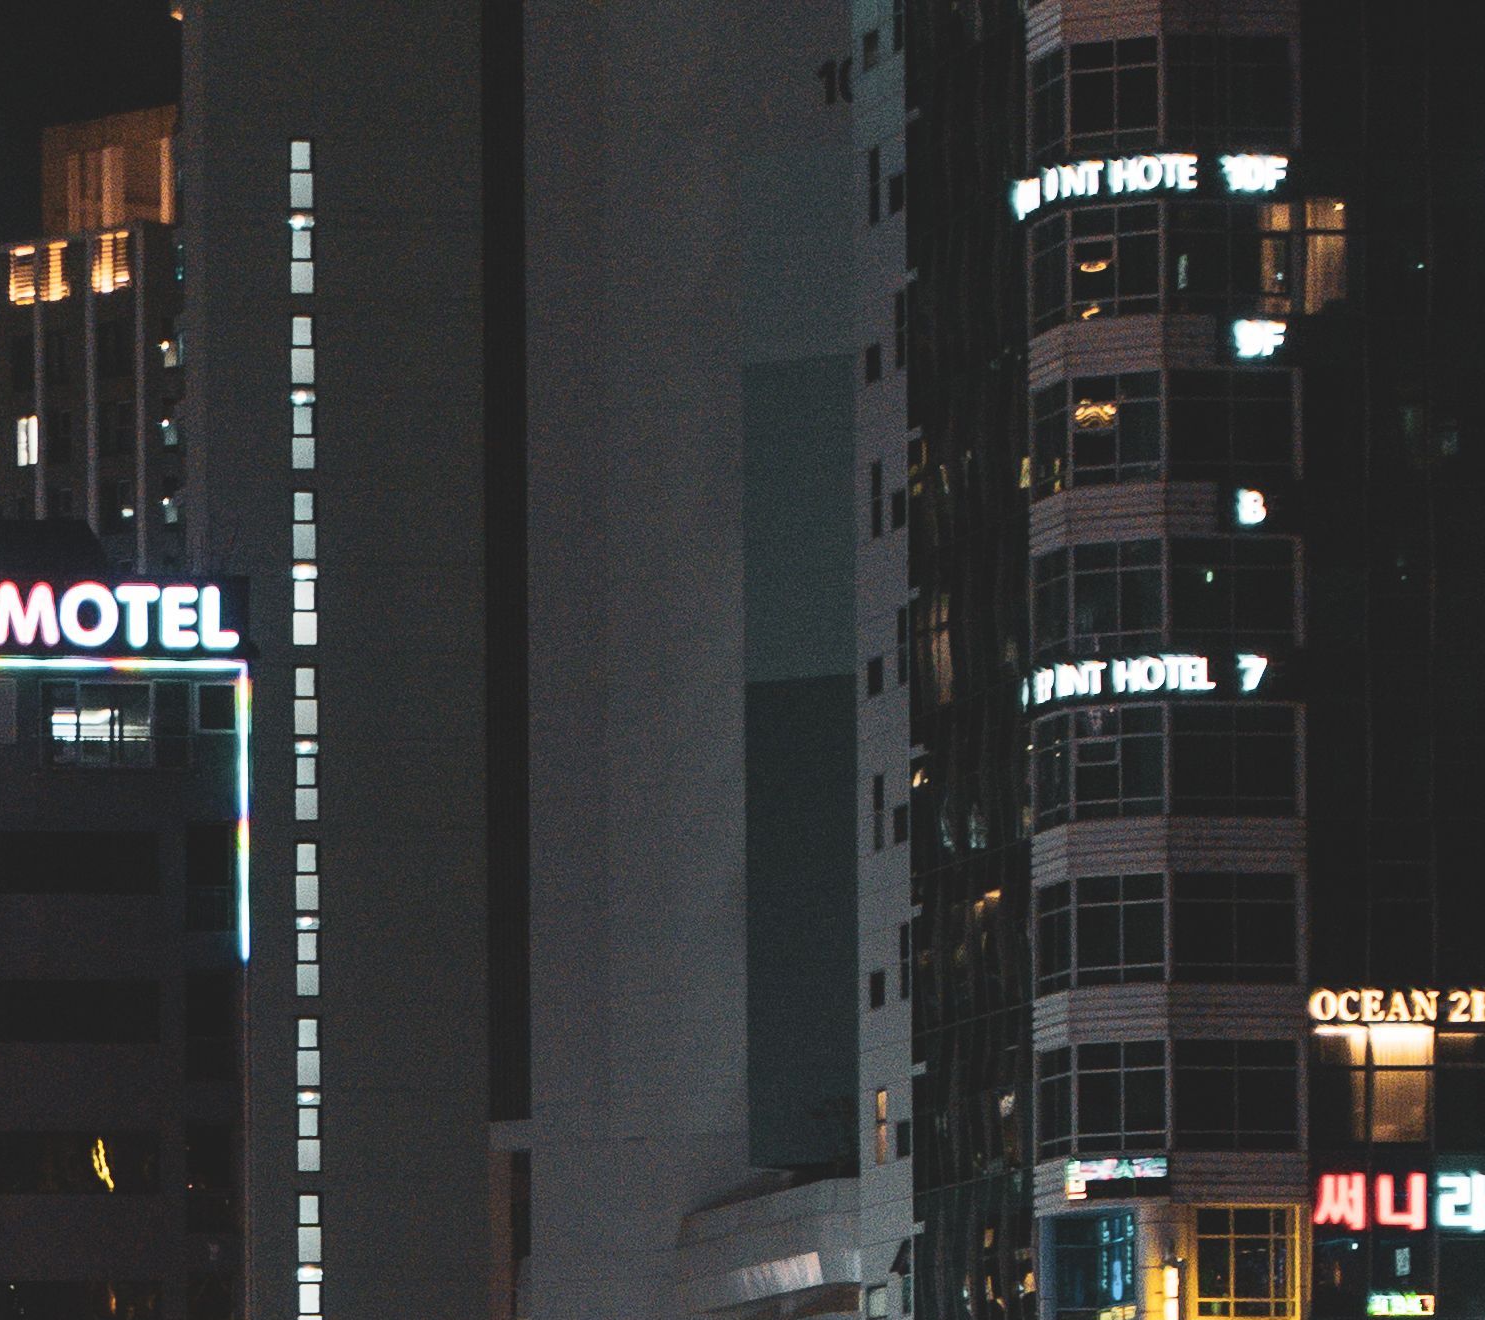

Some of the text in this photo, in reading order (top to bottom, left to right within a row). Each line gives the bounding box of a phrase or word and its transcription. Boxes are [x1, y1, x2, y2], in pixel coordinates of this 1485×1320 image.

[1112, 654, 1216, 693] HOTEL
[1238, 655, 1267, 691] 7
[1308, 989, 1437, 1021] OCEAN
